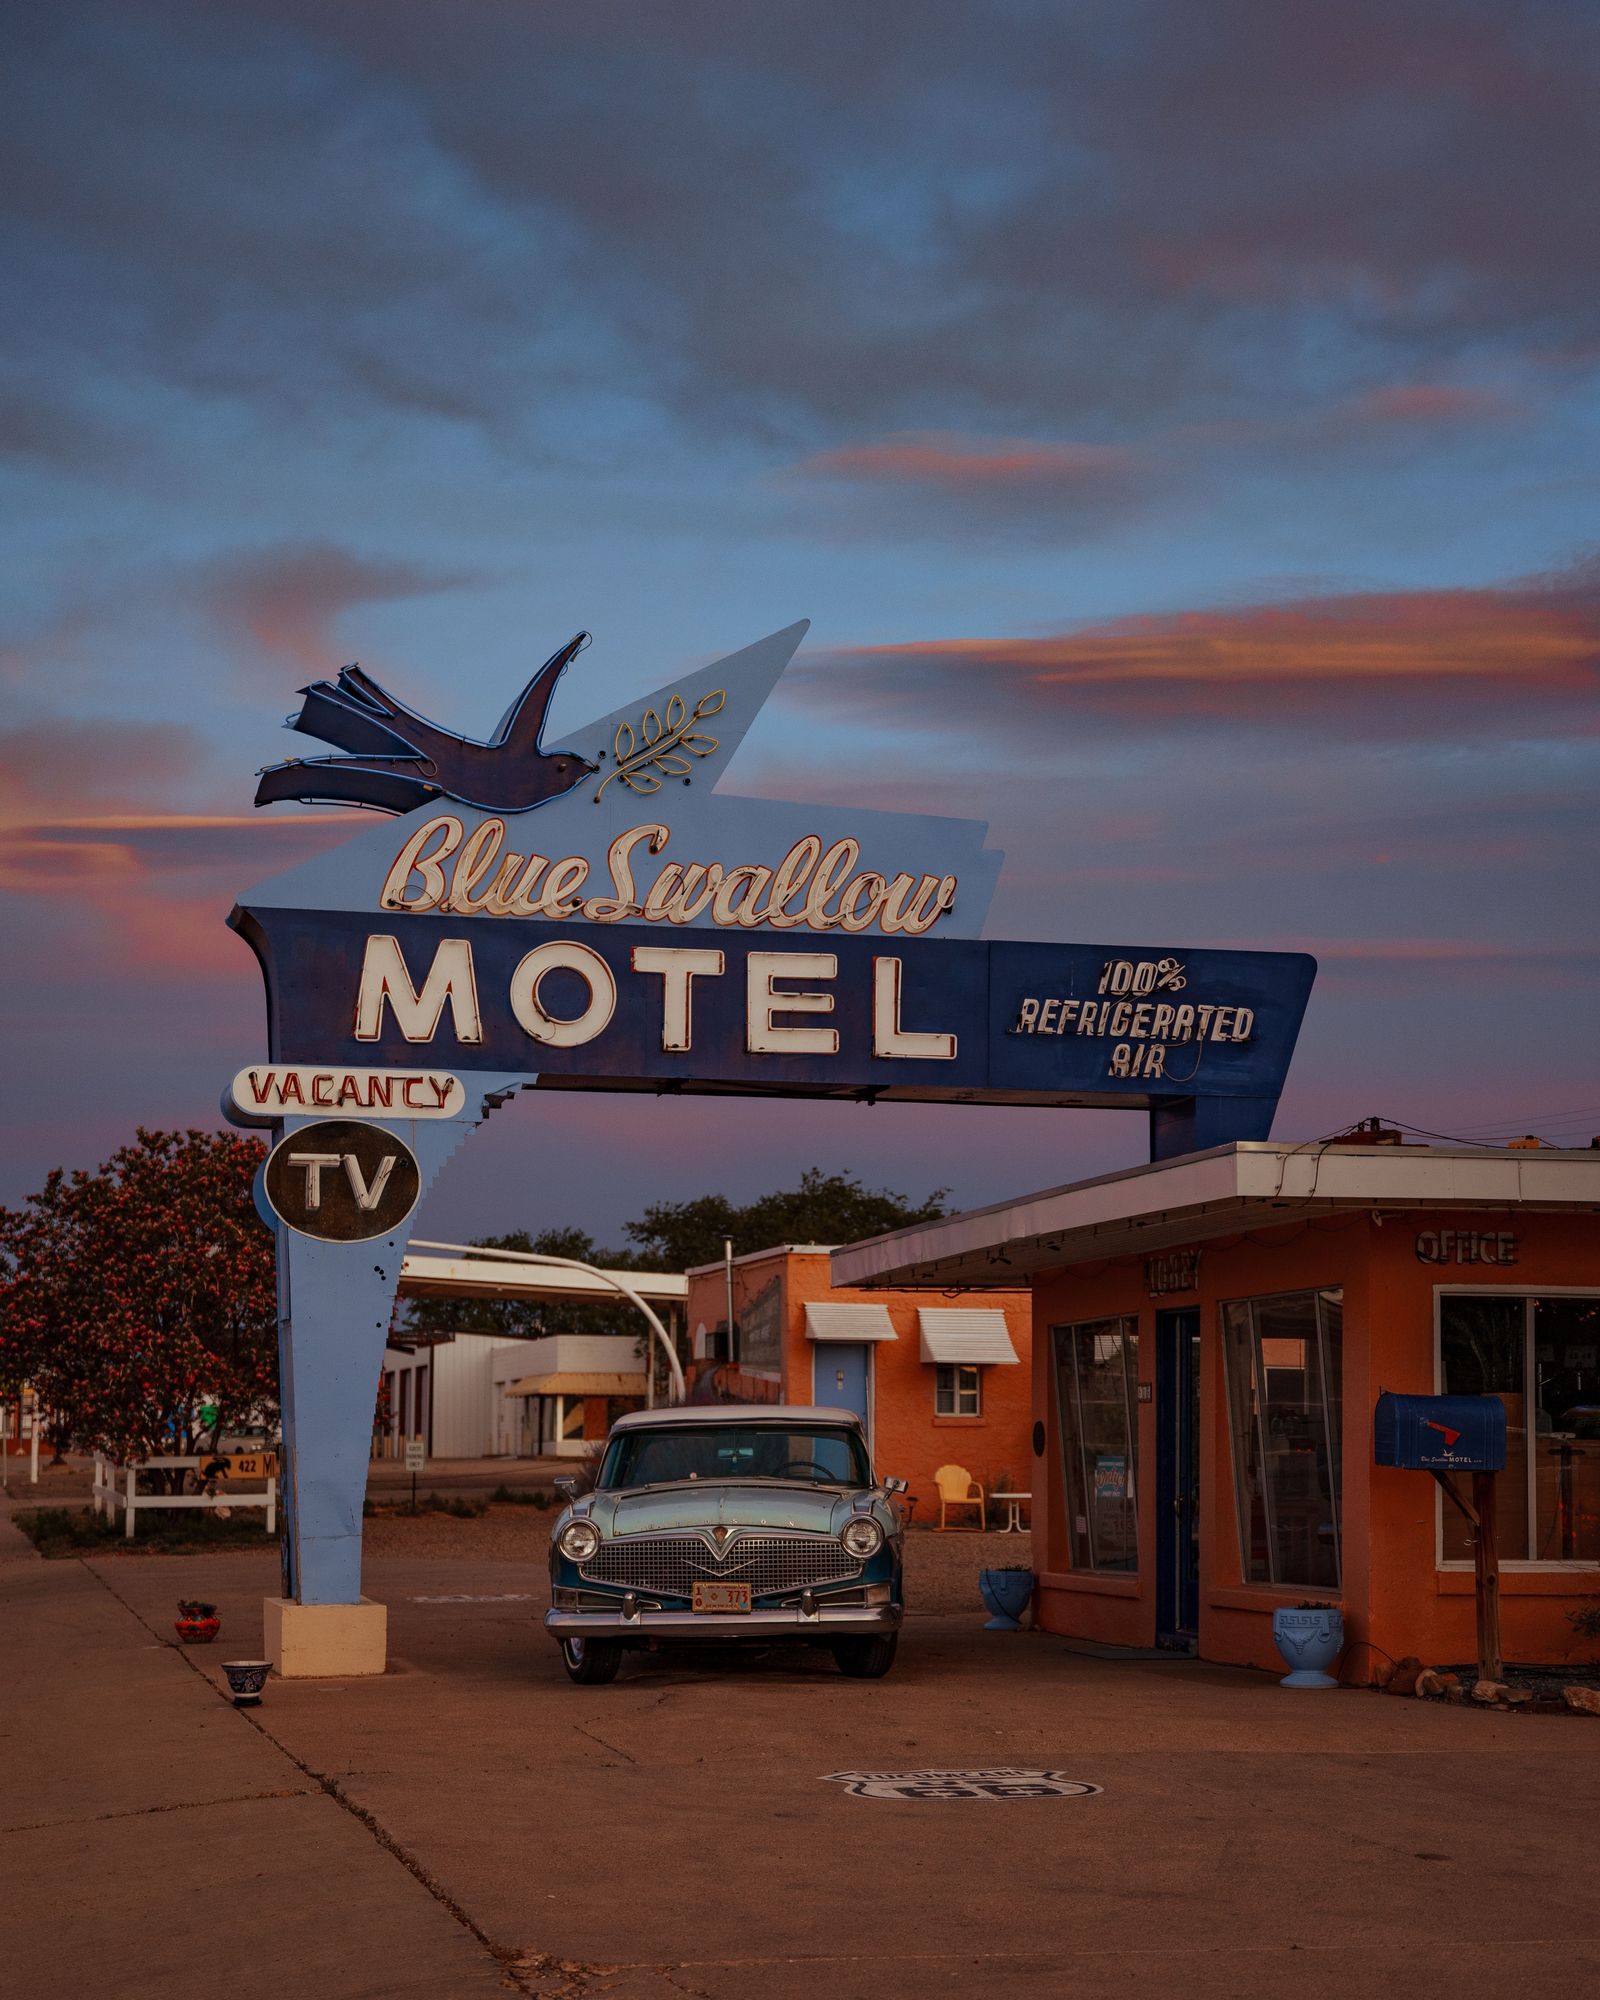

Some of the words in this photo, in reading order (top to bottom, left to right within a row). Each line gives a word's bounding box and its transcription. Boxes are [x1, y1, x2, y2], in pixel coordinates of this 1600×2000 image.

[380, 815, 590, 919] Blue
[582, 823, 957, 933] Swallow
[1097, 956, 1187, 997] 100%
[353, 934, 959, 1060] MOTEL
[1015, 998, 1254, 1042] REFRIGERATED
[1107, 1043, 1166, 1079] AIR
[250, 1070, 454, 1109] VACANCY
[287, 1152, 397, 1211] TV
[1416, 1230, 1517, 1265] OFFICE
[238, 1460, 257, 1473] 422
[726, 1590, 748, 1604] 373
[861, 1771, 1028, 1781] TUCUMCARI
[896, 1783, 1063, 1798] 66
